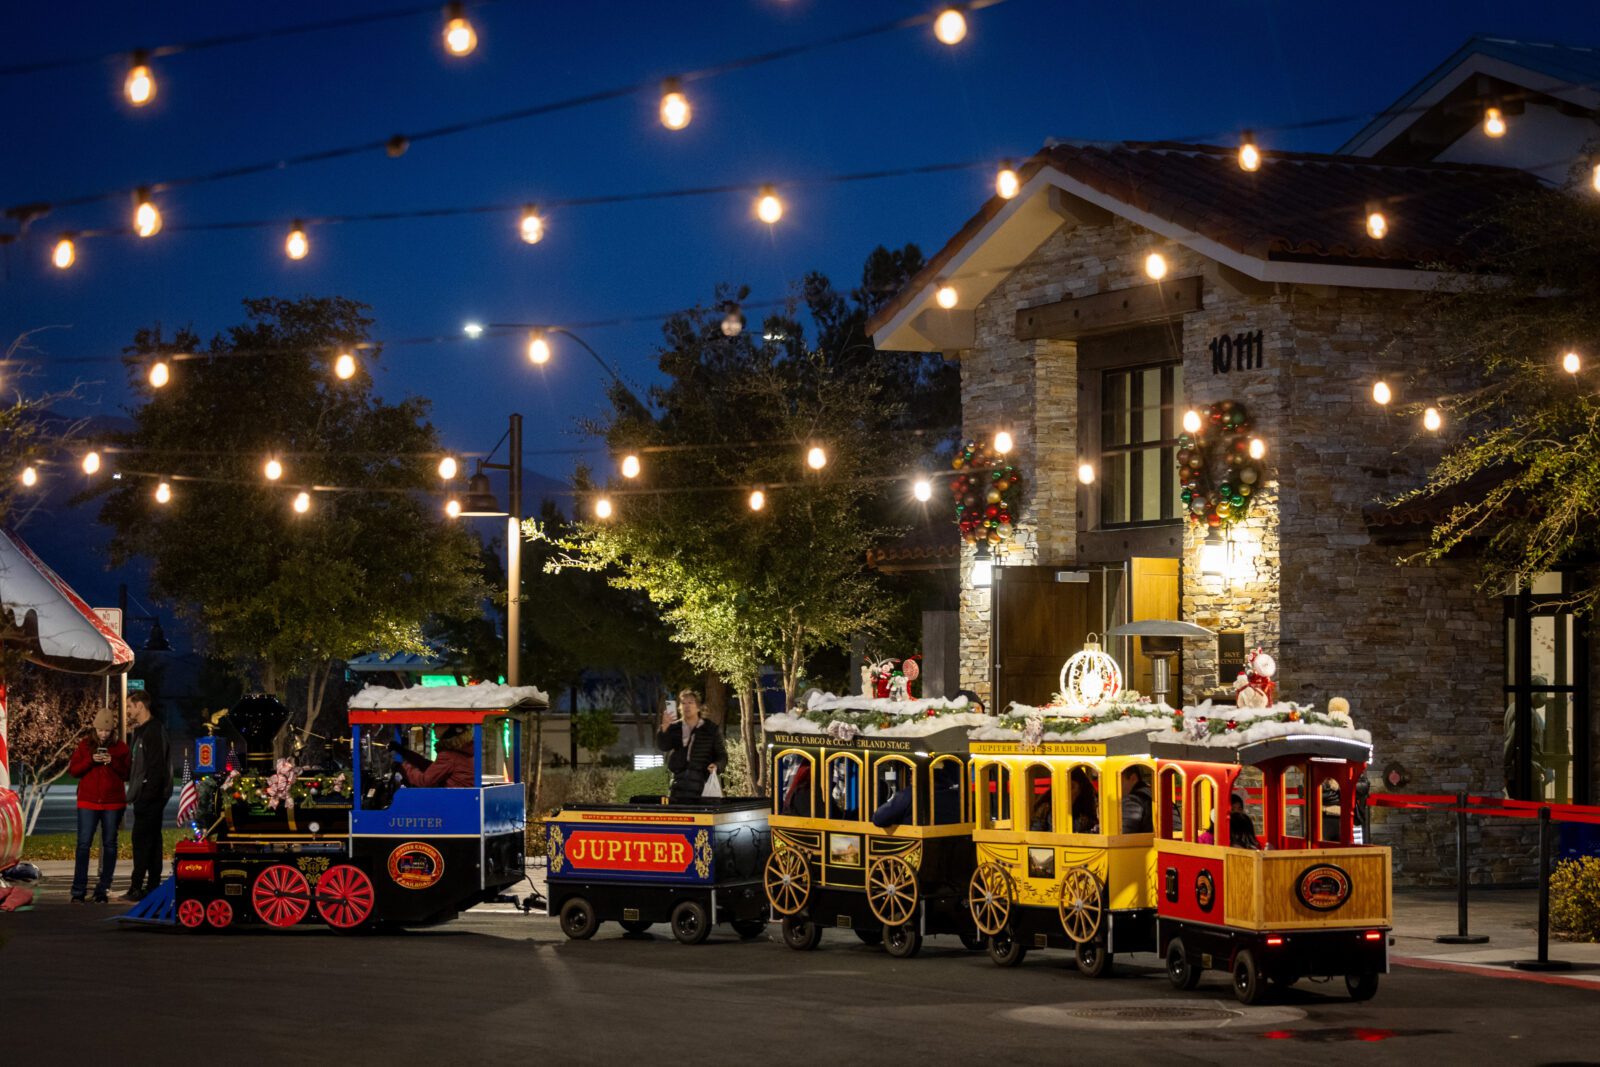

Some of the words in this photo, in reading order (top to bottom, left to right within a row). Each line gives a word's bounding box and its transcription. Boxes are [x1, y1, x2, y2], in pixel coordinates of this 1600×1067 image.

[1209, 329, 1263, 374] 10111
[774, 734, 801, 744] WELLS,
[801, 736, 825, 745] FARGO
[887, 740, 912, 750] STAGE
[978, 744, 1012, 752] JUPITER
[1054, 745, 1097, 753] RAILROAD
[388, 817, 442, 828] JUPITER
[572, 839, 685, 863] JUPITER
